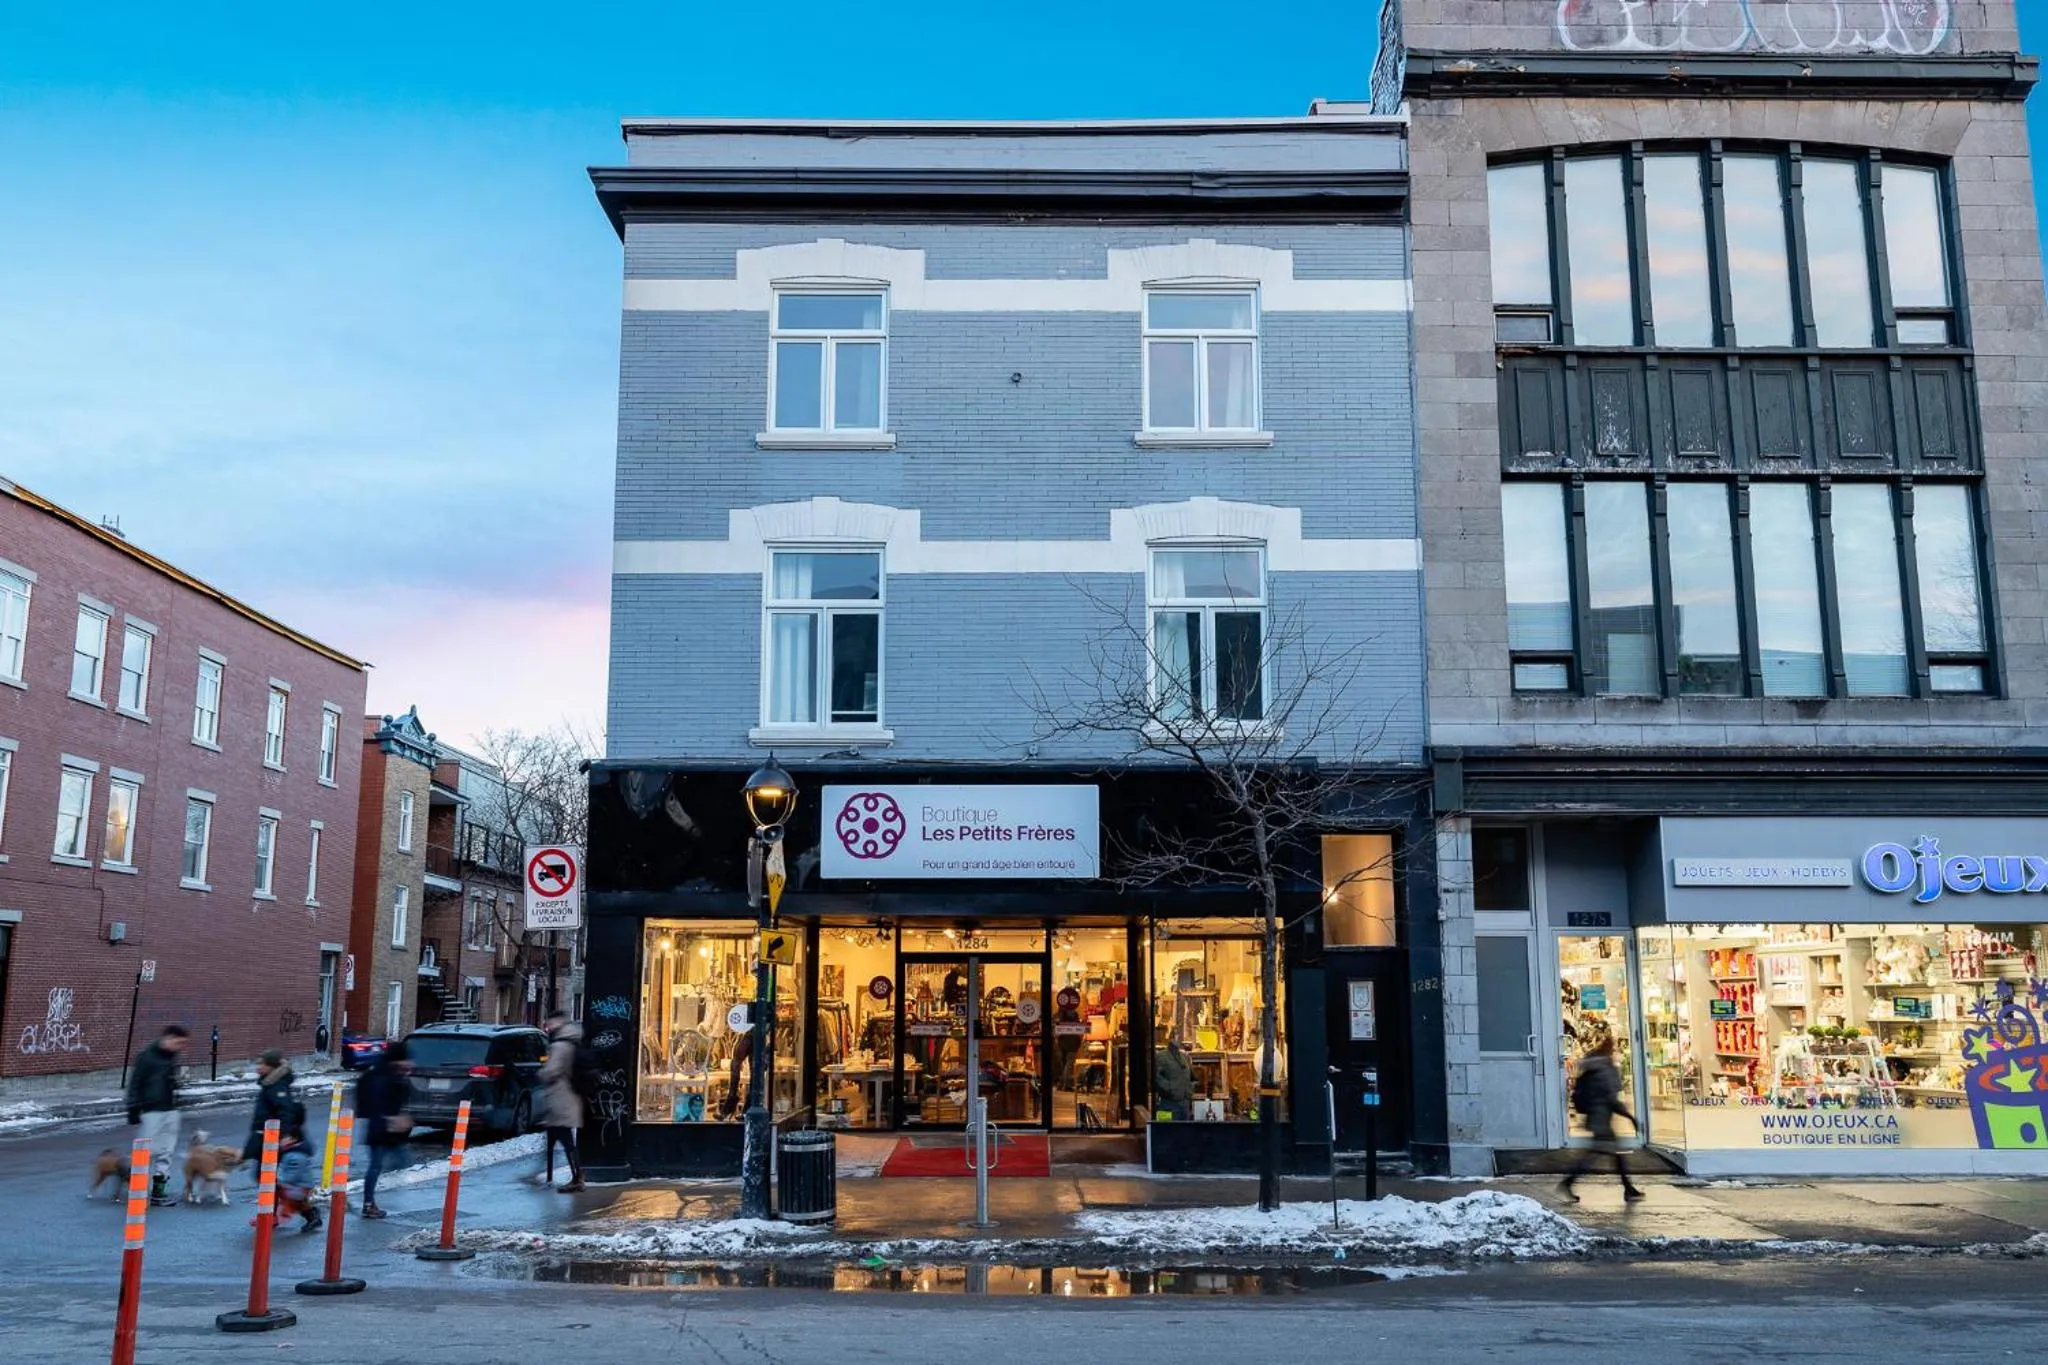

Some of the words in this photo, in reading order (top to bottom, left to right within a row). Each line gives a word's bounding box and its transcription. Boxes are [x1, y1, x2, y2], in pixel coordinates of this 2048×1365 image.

[922, 806, 998, 825] Boutique
[922, 826, 955, 841] Les
[959, 826, 1013, 841] Petits
[1017, 825, 1075, 841] Frères
[922, 860, 945, 869] Pour
[947, 861, 960, 869] un
[962, 859, 991, 871] grand
[1013, 859, 1035, 869] bien
[1864, 835, 2048, 903] Ojeux
[1681, 867, 1734, 878] JOUETS
[1745, 867, 1779, 878] JEUX
[957, 937, 989, 950] 1284
[1412, 977, 1439, 993] 1282
[1691, 1098, 1725, 1106] OJEUX
[1761, 1114, 1899, 1129] WWW.OJEUX.CA
[1763, 1133, 1833, 1145] BOUTIQUE
[1838, 1133, 1856, 1145] EN
[1860, 1133, 1901, 1145] LIGNE
